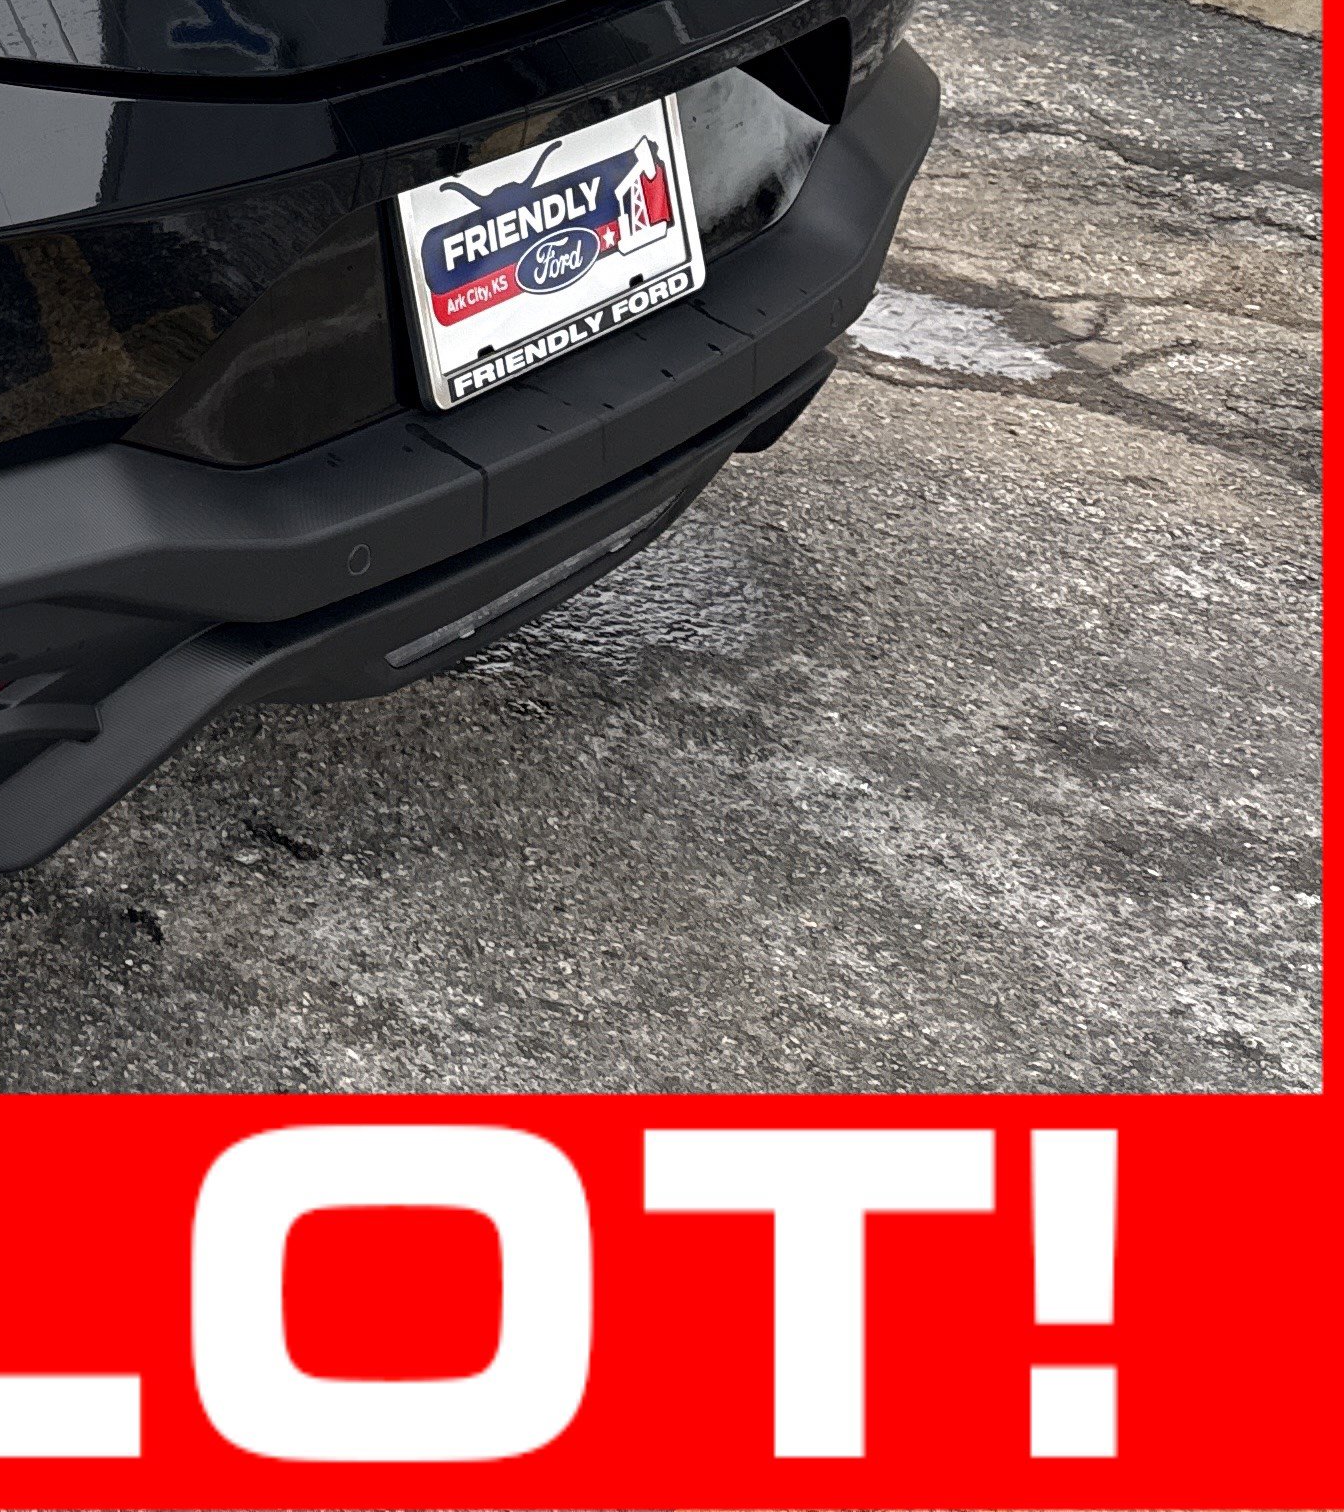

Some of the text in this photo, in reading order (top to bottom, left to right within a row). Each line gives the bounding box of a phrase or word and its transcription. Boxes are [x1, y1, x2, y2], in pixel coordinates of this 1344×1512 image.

[443, 177, 601, 271] FRIENDLY
[447, 274, 509, 315] Ark City, KS
[533, 237, 584, 285] Ford
[453, 272, 689, 399] FRIENDLY FORD
